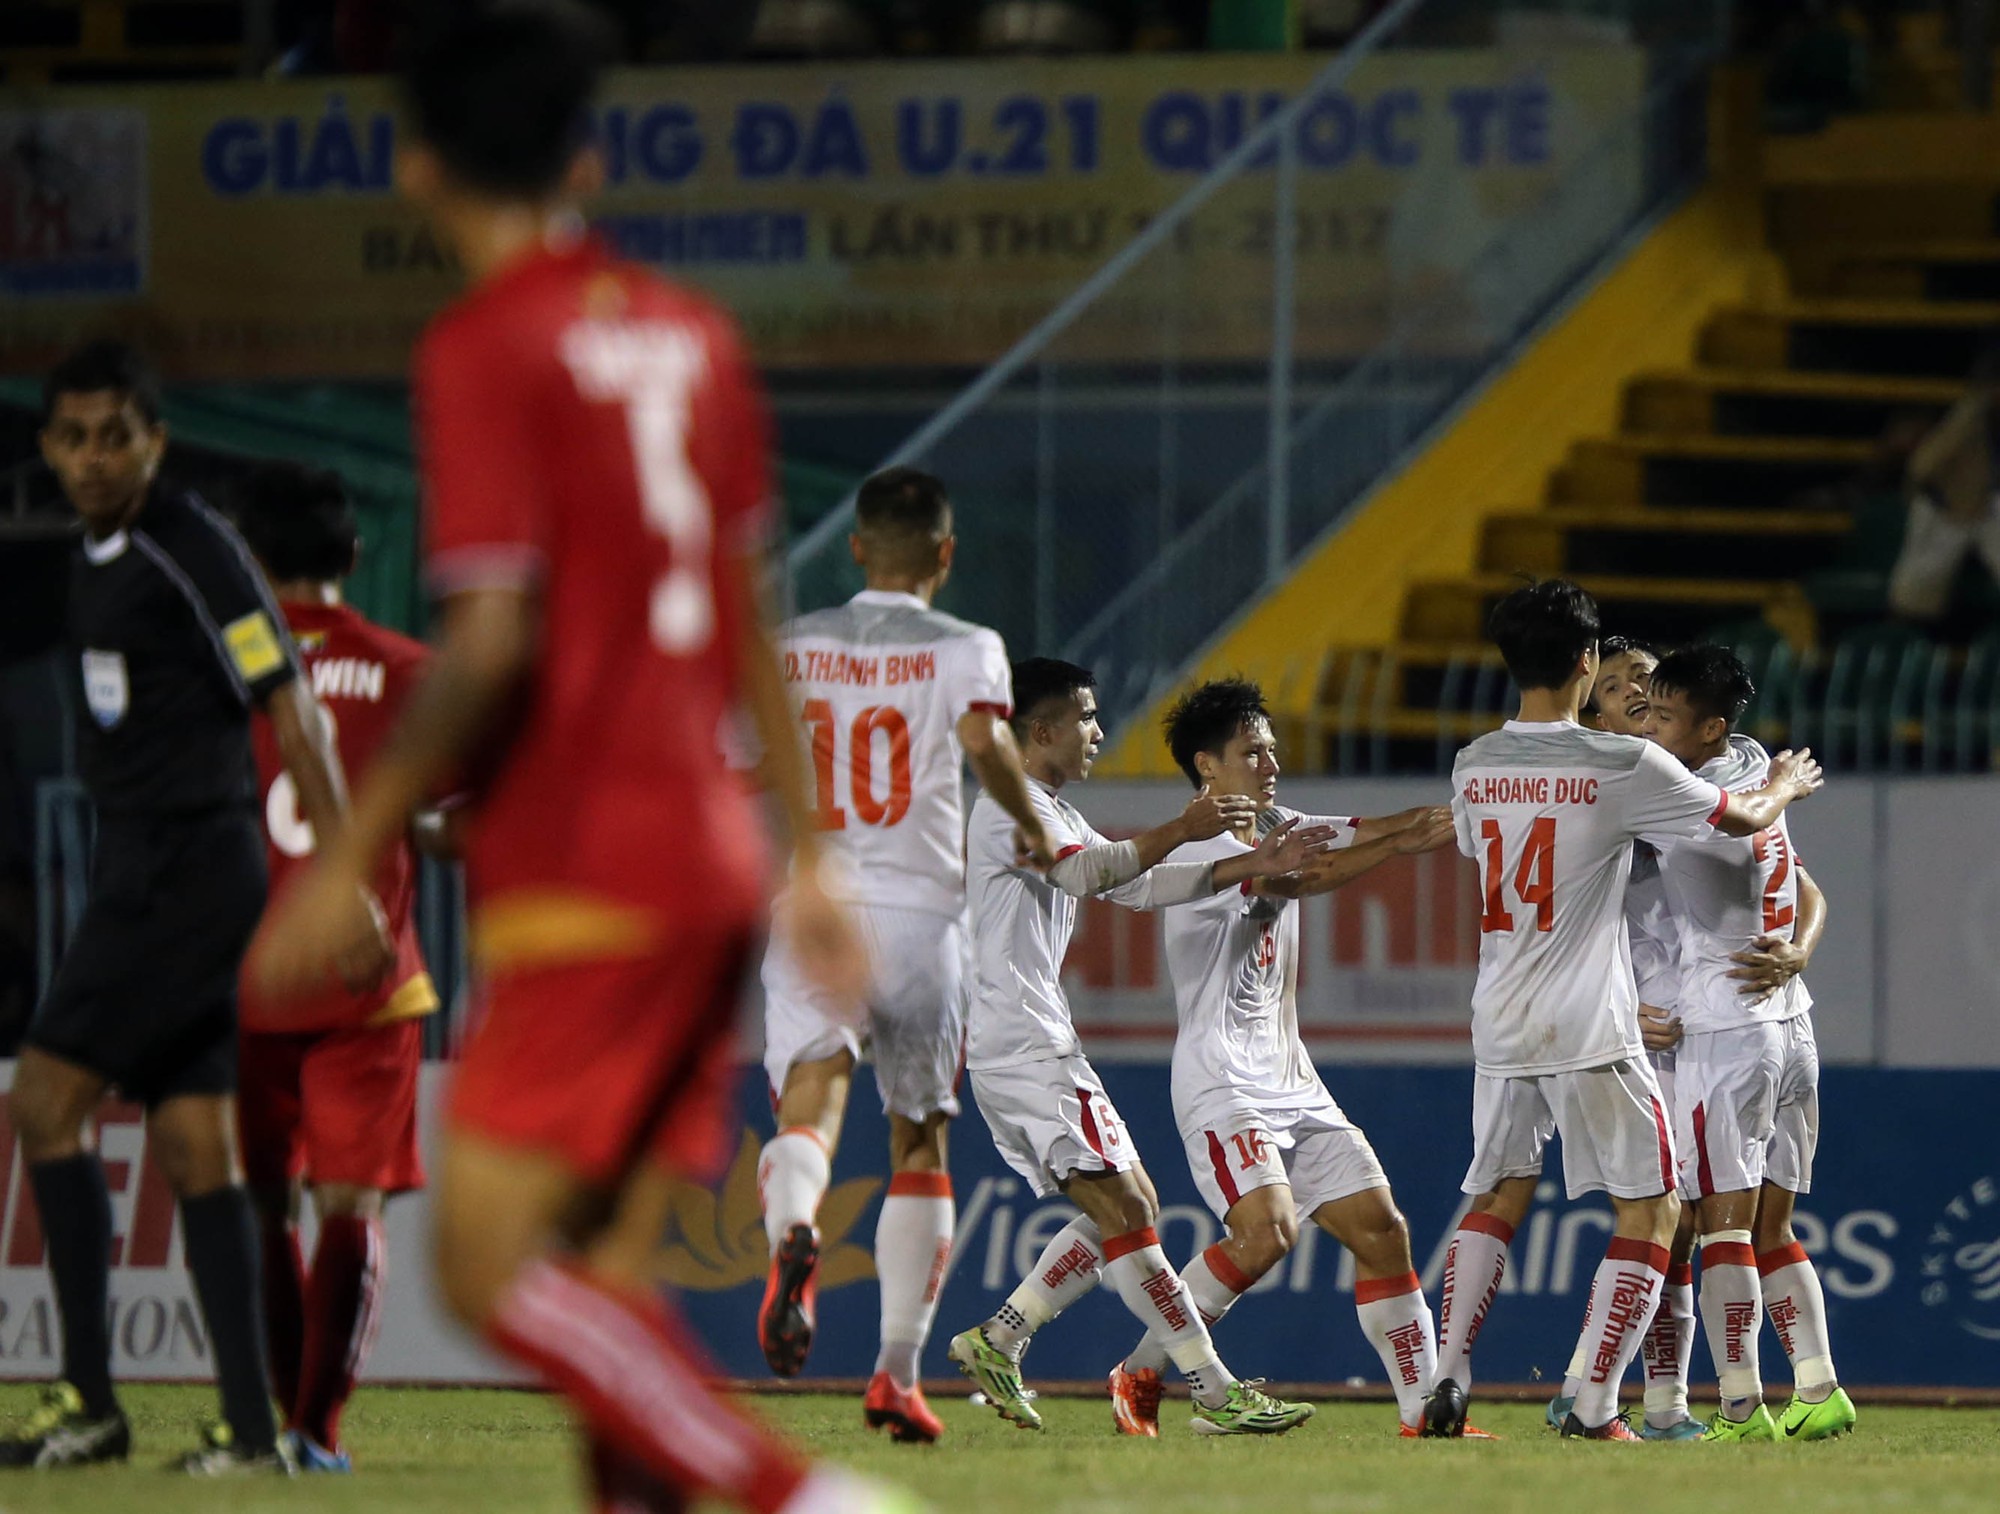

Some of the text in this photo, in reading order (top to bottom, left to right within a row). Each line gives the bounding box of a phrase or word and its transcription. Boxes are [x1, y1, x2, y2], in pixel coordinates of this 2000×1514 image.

[898, 96, 1100, 178] U.21
[801, 698, 912, 829] 10
[1554, 777, 1599, 805] DUC
[1480, 816, 1557, 933] 14
[1098, 1104, 1120, 1147] 5
[1230, 1128, 1268, 1171] 16
